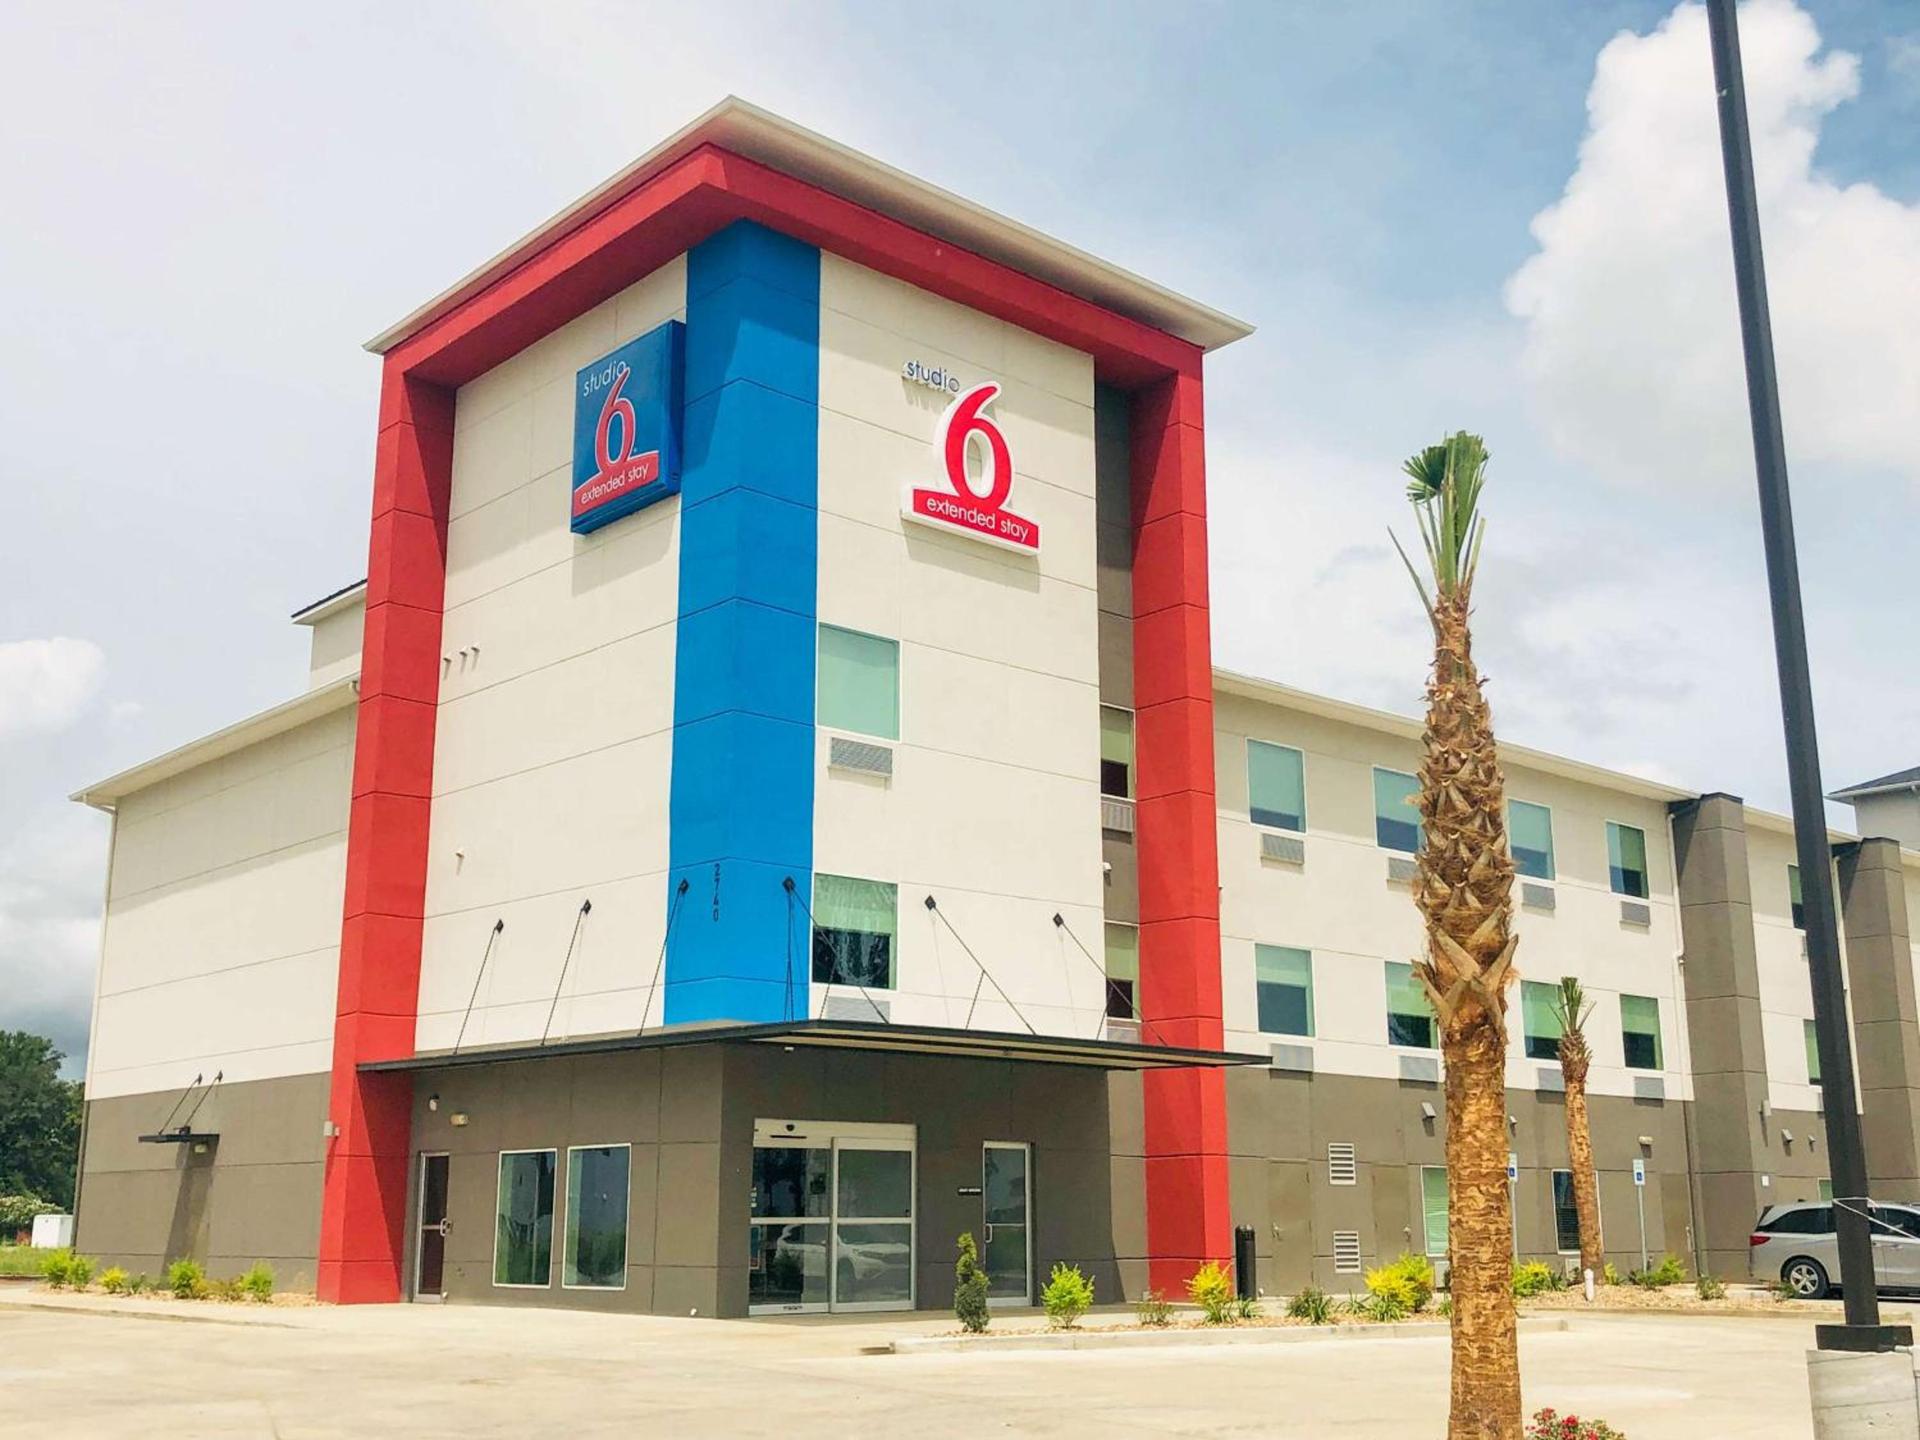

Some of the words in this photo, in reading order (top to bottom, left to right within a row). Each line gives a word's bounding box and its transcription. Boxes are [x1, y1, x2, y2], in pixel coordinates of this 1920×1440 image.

[584, 359, 627, 397] studio
[907, 360, 960, 392] studio
[595, 367, 636, 471] 6
[945, 385, 1012, 506] 6
[580, 469, 625, 505] extended
[627, 463, 649, 483] stay
[926, 497, 995, 529] extended
[1000, 518, 1029, 541] stay
